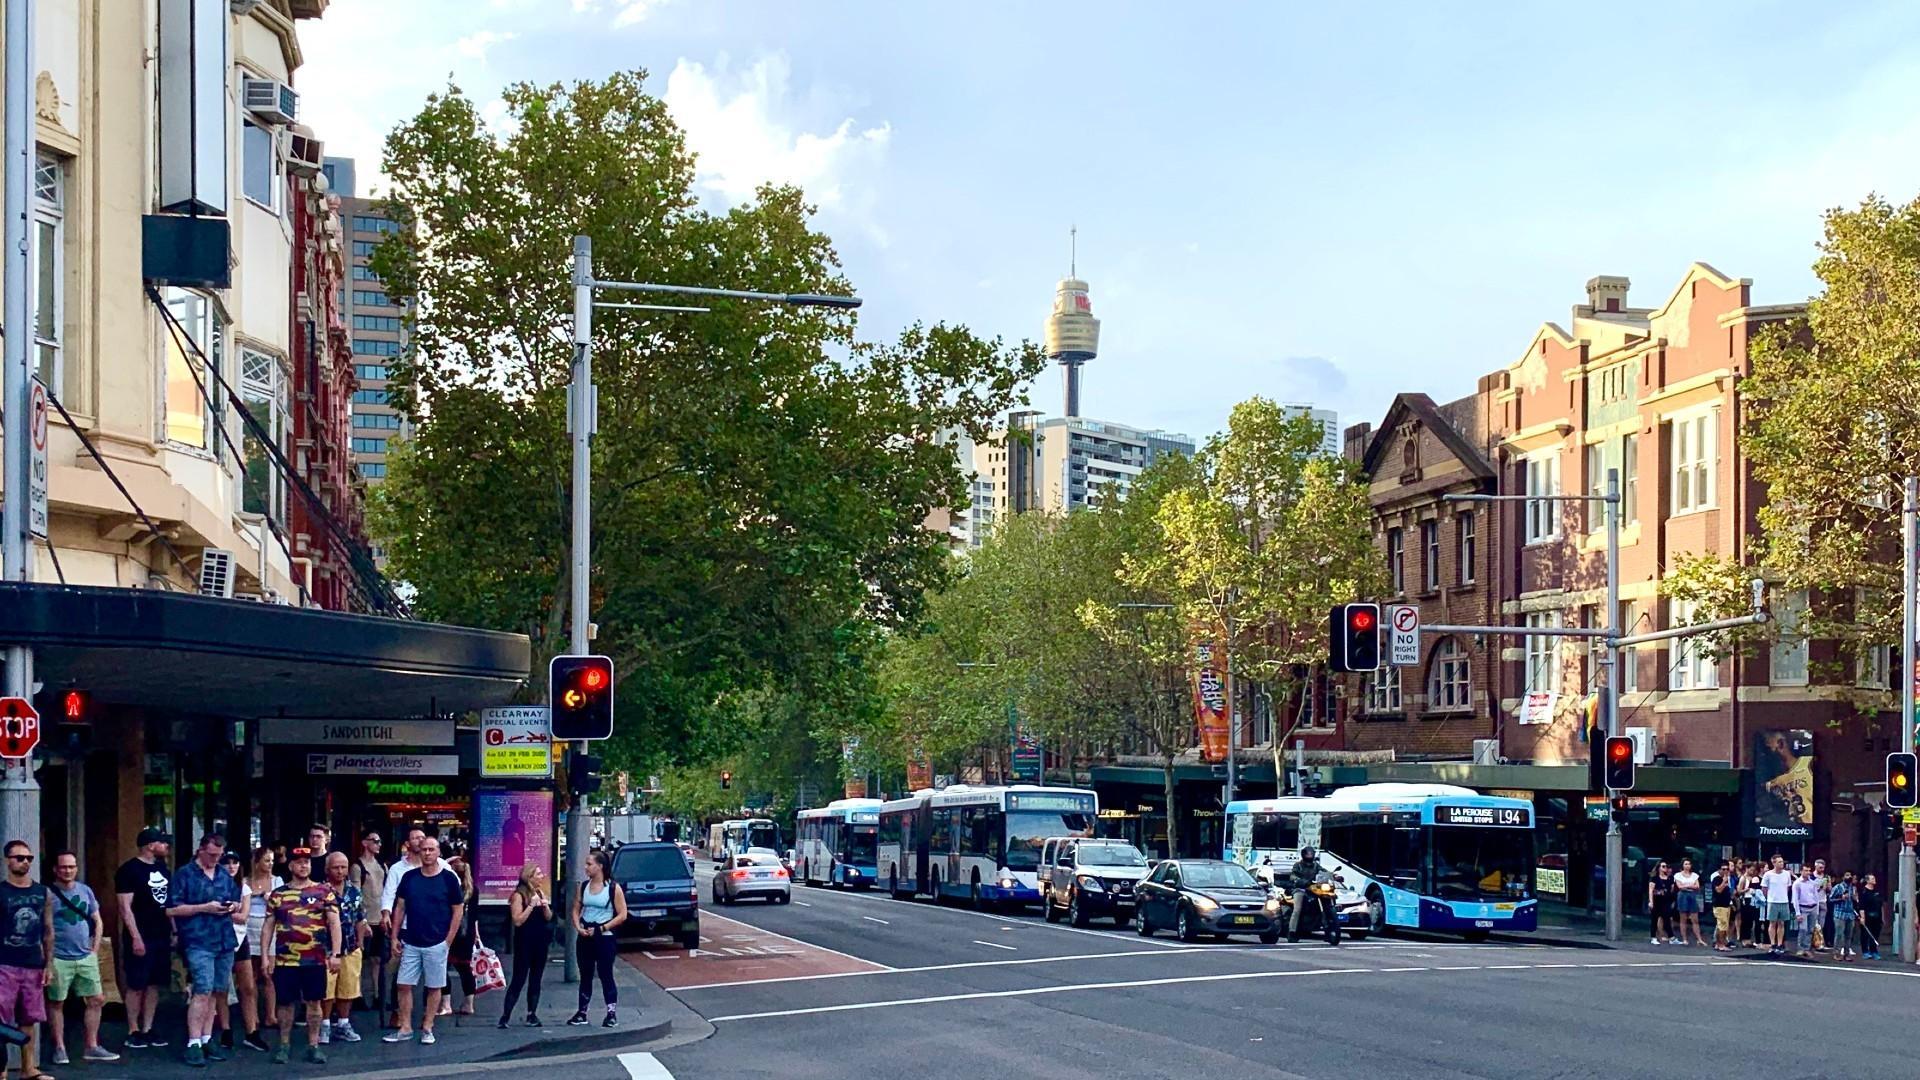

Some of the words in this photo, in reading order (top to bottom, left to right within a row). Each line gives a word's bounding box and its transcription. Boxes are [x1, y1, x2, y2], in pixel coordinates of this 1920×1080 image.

[33, 460, 44, 483] NO
[1397, 634, 1414, 644] NO
[1394, 645, 1417, 653] RIGHT
[489, 710, 544, 718] CLEARWAY
[0, 716, 36, 739] TOP
[489, 730, 500, 744] C
[333, 755, 423, 770] planetdwellers
[366, 781, 446, 795] Zambrero
[1450, 807, 1461, 816] LA
[1462, 808, 1494, 817] PEROUSE
[1499, 809, 1520, 825] L94
[1759, 826, 1809, 836] Throwback.
[642, 946, 805, 960] LANE
